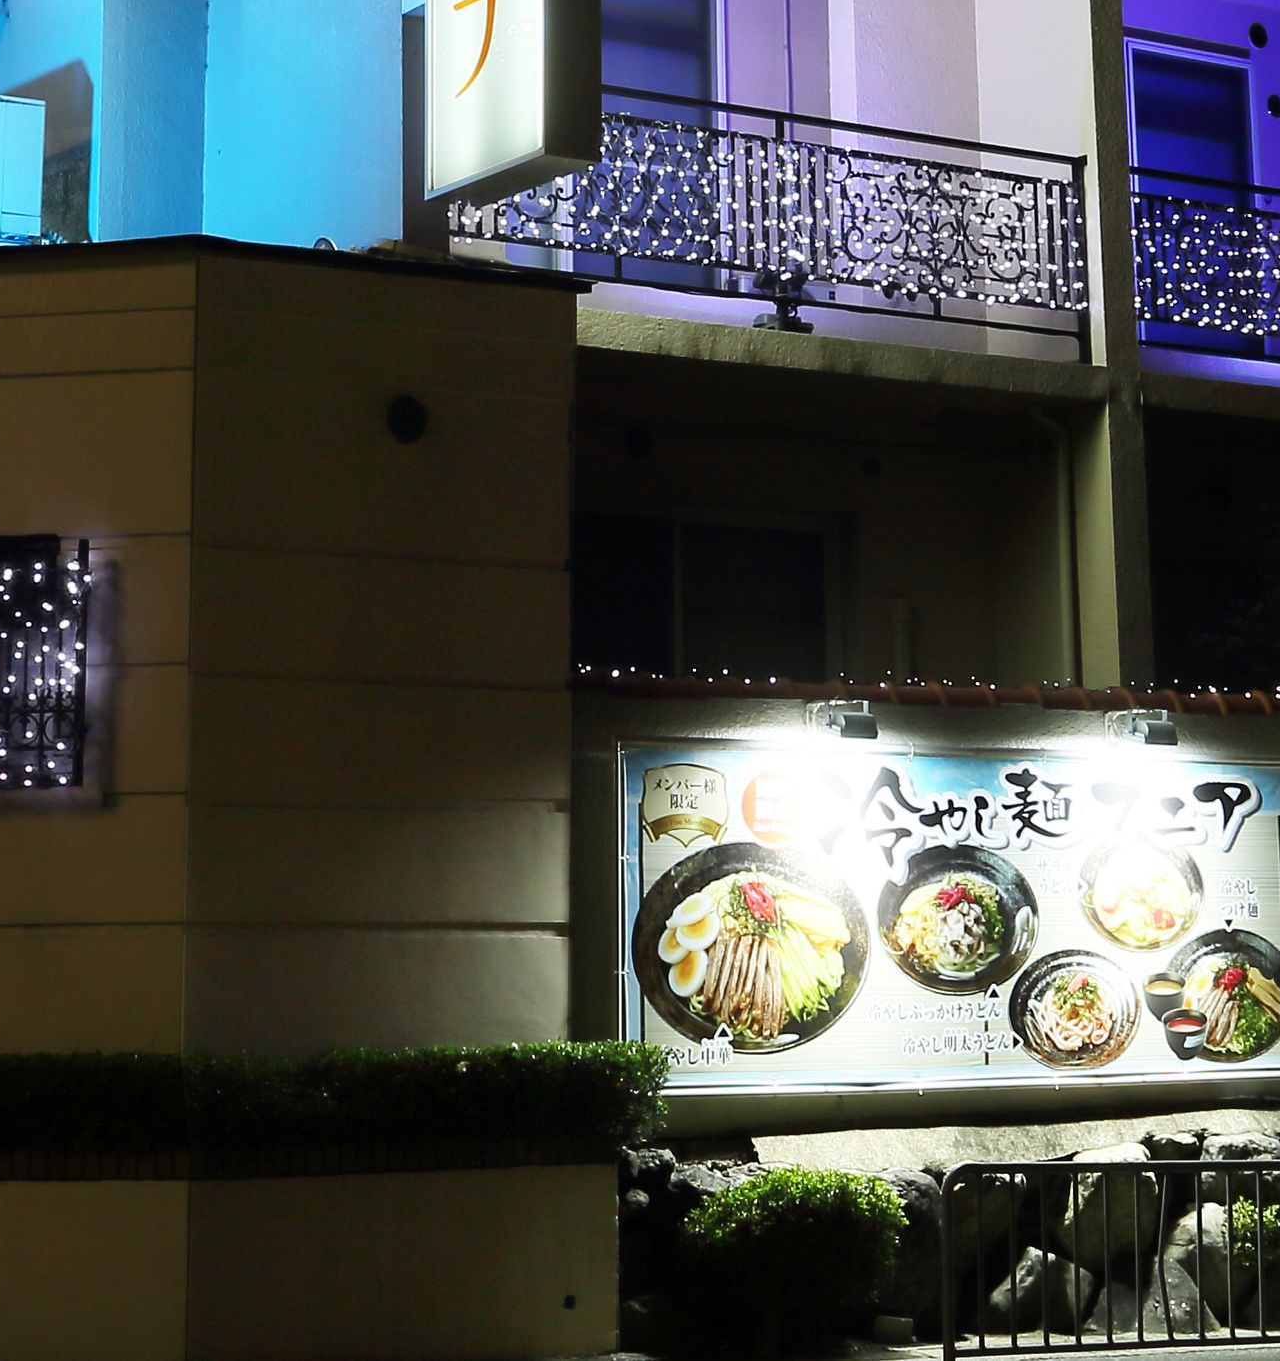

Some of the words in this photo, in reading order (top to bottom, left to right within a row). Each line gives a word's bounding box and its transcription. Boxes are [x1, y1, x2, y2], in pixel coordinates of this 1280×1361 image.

[652, 777, 717, 794] メンバー様
[669, 793, 699, 810] 限定
[1221, 879, 1257, 896] 冷やし
[1221, 902, 1259, 918] つけ麺
[903, 1033, 1010, 1055] 冷やし明太うどん
